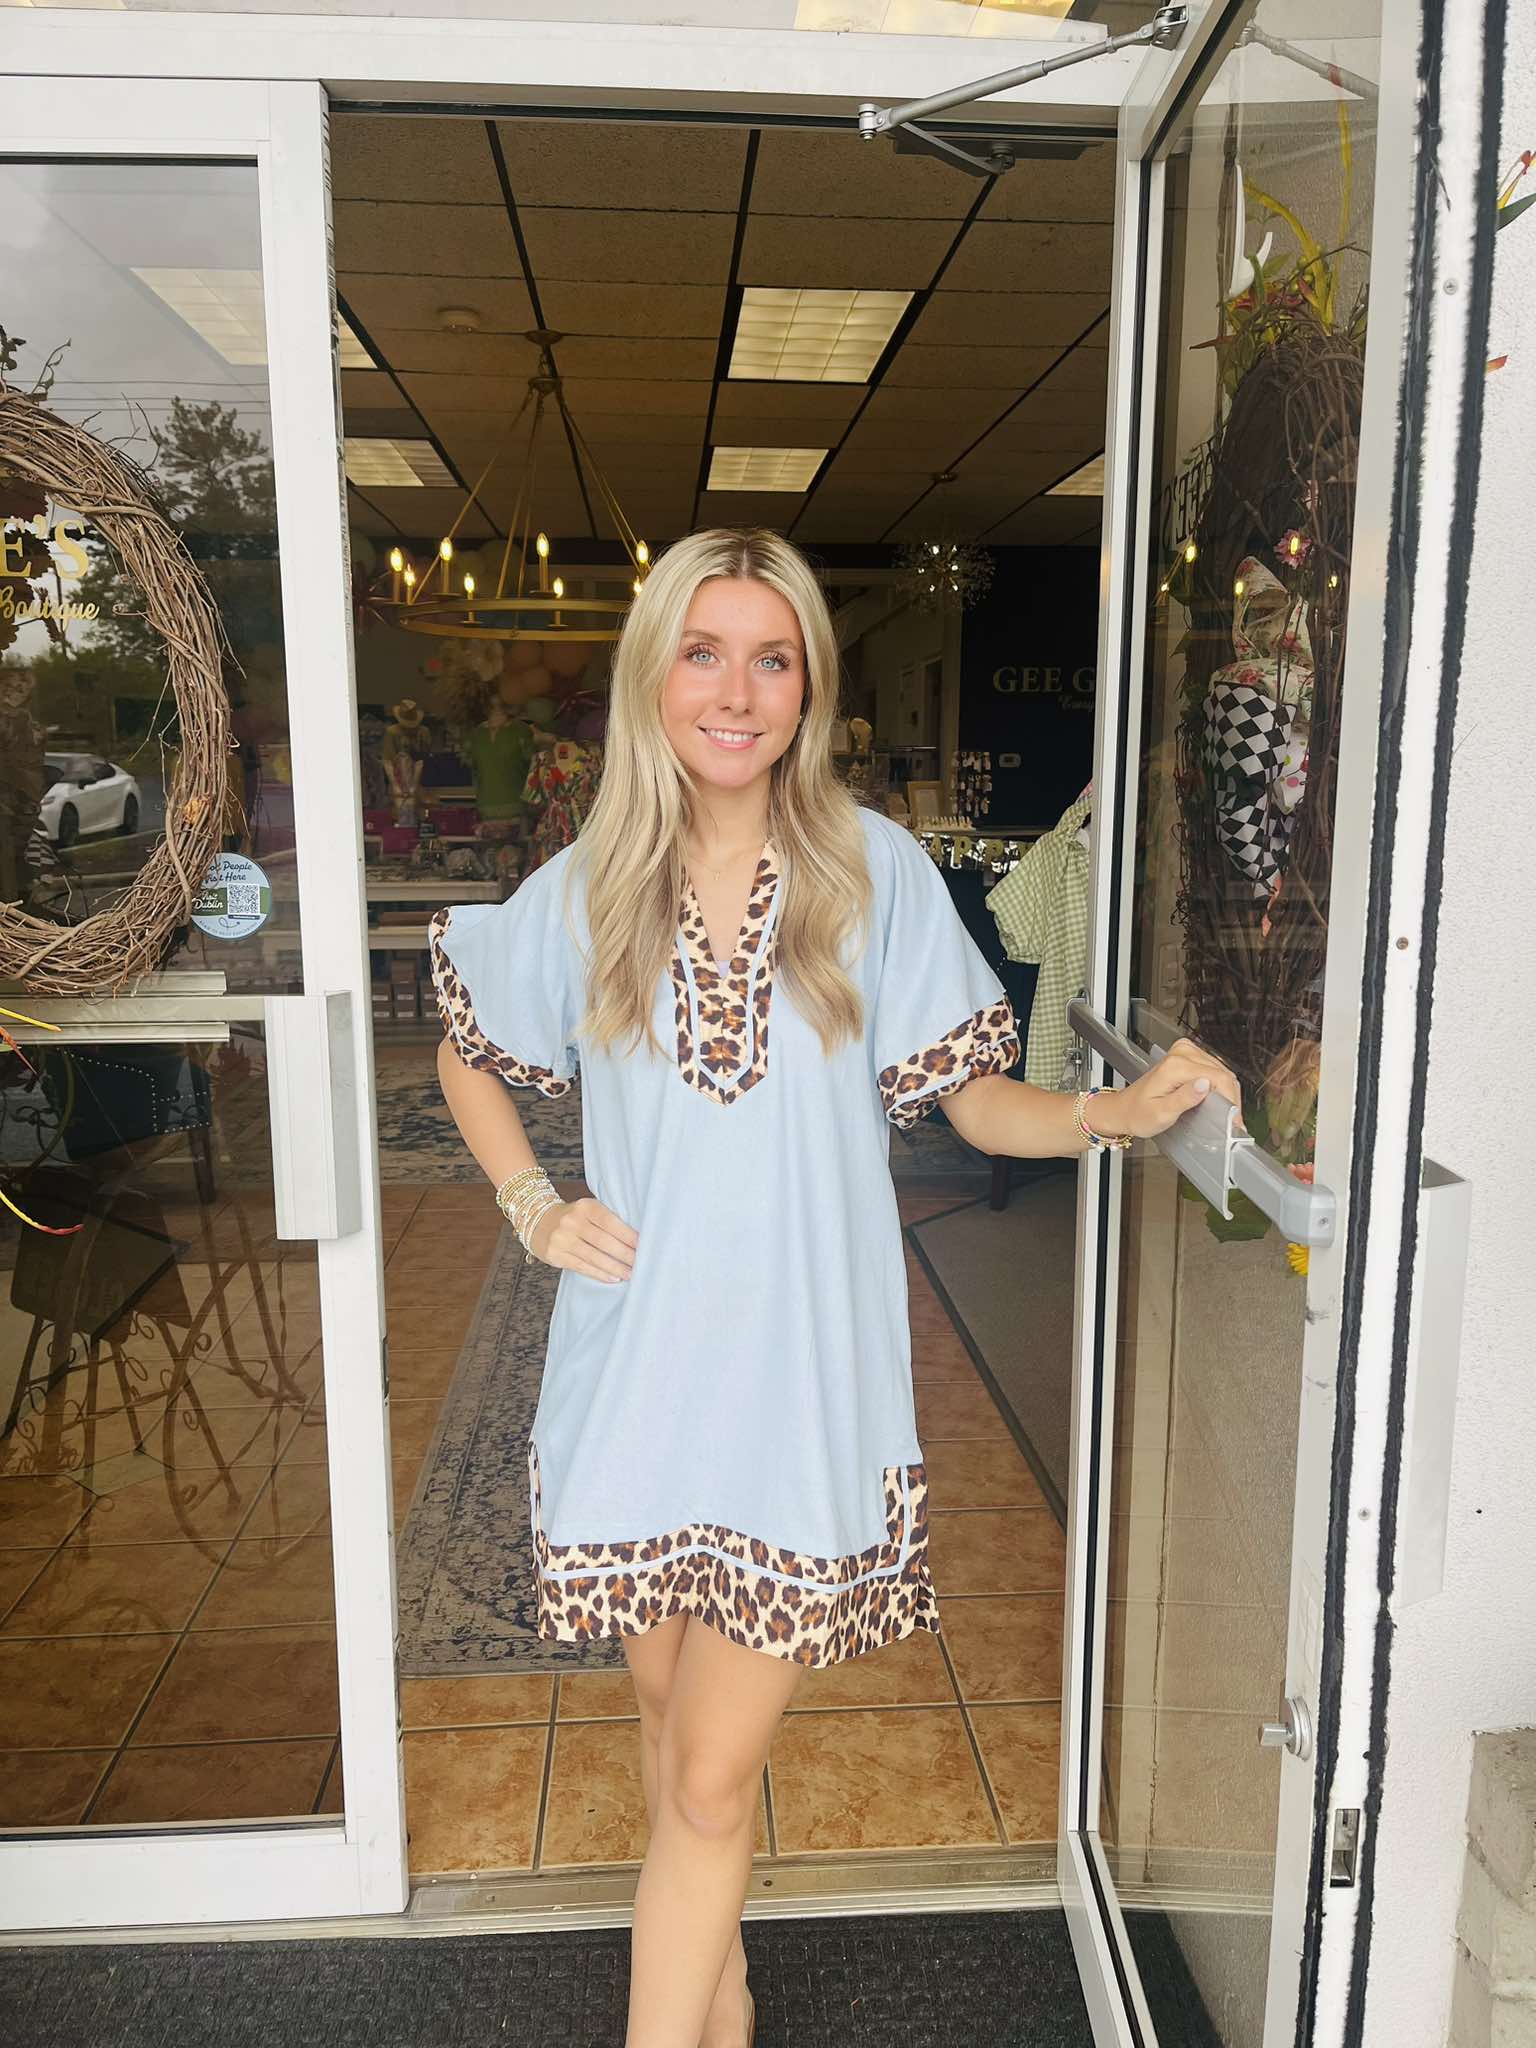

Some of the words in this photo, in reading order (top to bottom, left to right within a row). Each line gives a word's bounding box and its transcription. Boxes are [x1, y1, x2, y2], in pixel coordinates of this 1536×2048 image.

[0, 585, 100, 633] Boutique
[992, 666, 1063, 692] GEE
[223, 860, 252, 871] People
[225, 872, 247, 881] Here
[191, 898, 223, 909] Dublin
